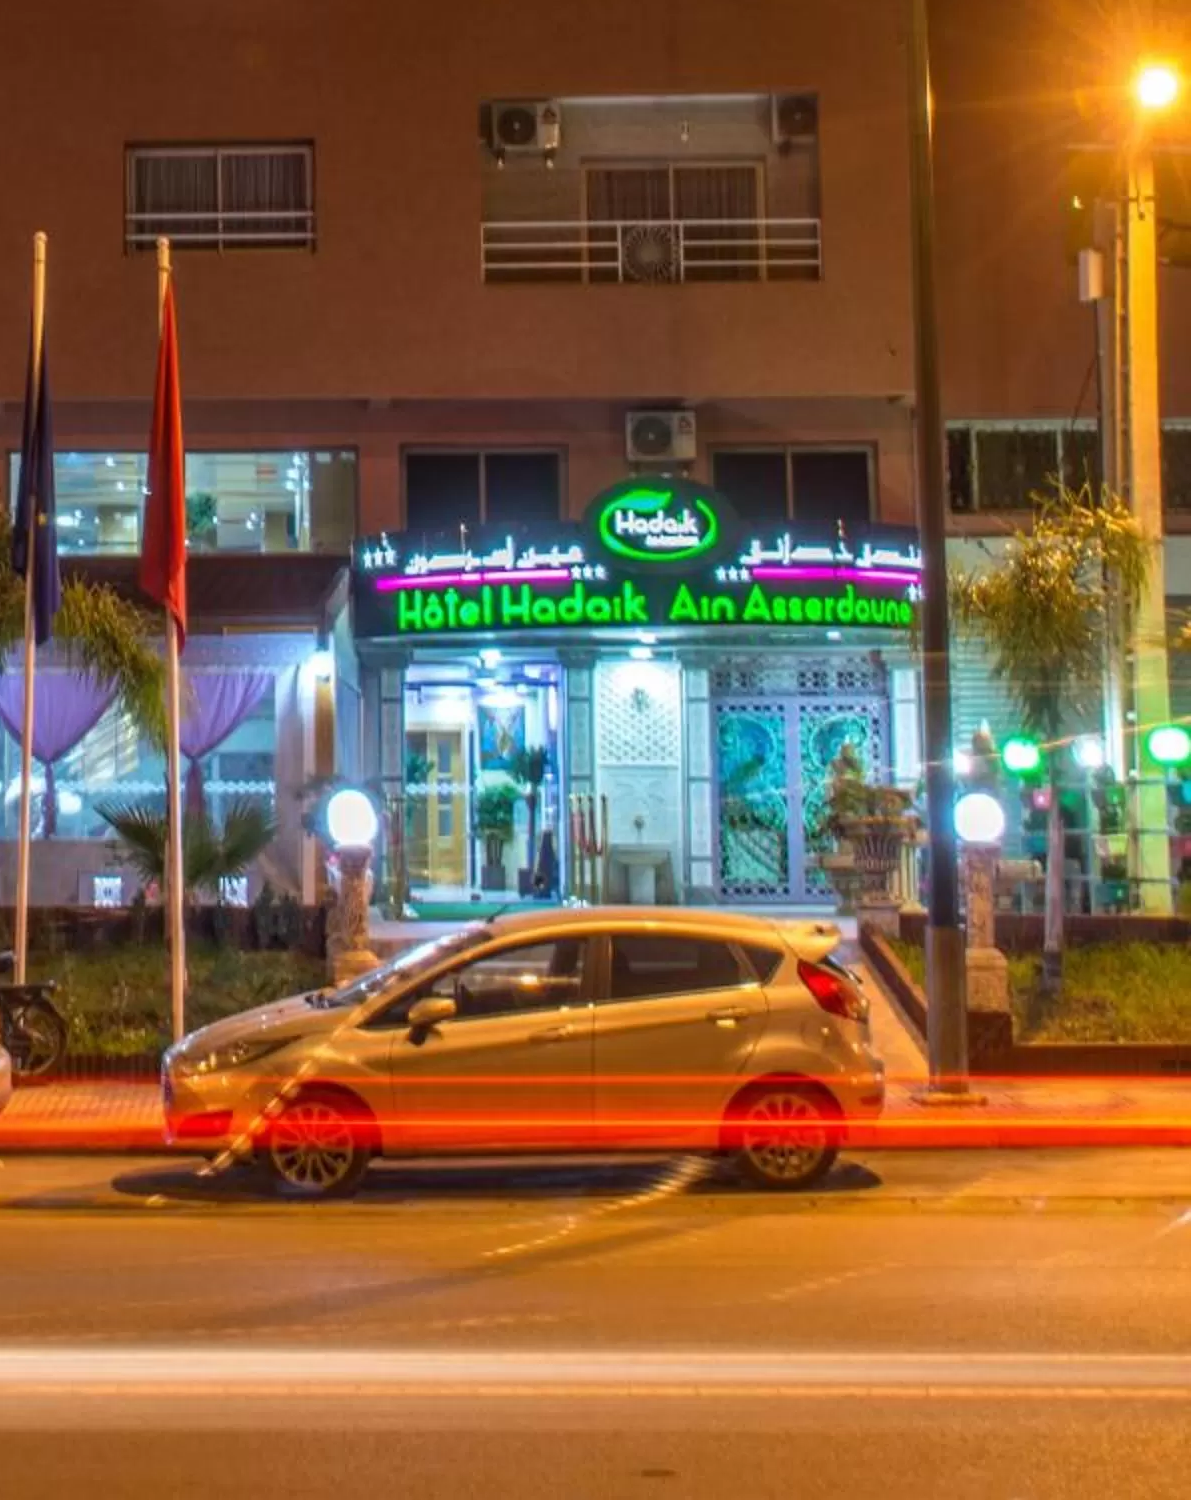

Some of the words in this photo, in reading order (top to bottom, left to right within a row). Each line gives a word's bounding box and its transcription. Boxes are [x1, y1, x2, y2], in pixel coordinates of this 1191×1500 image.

[615, 508, 699, 534] Hadaik
[398, 583, 494, 630] Hôtel
[501, 580, 649, 626] Hadaik
[668, 583, 737, 621] Ain
